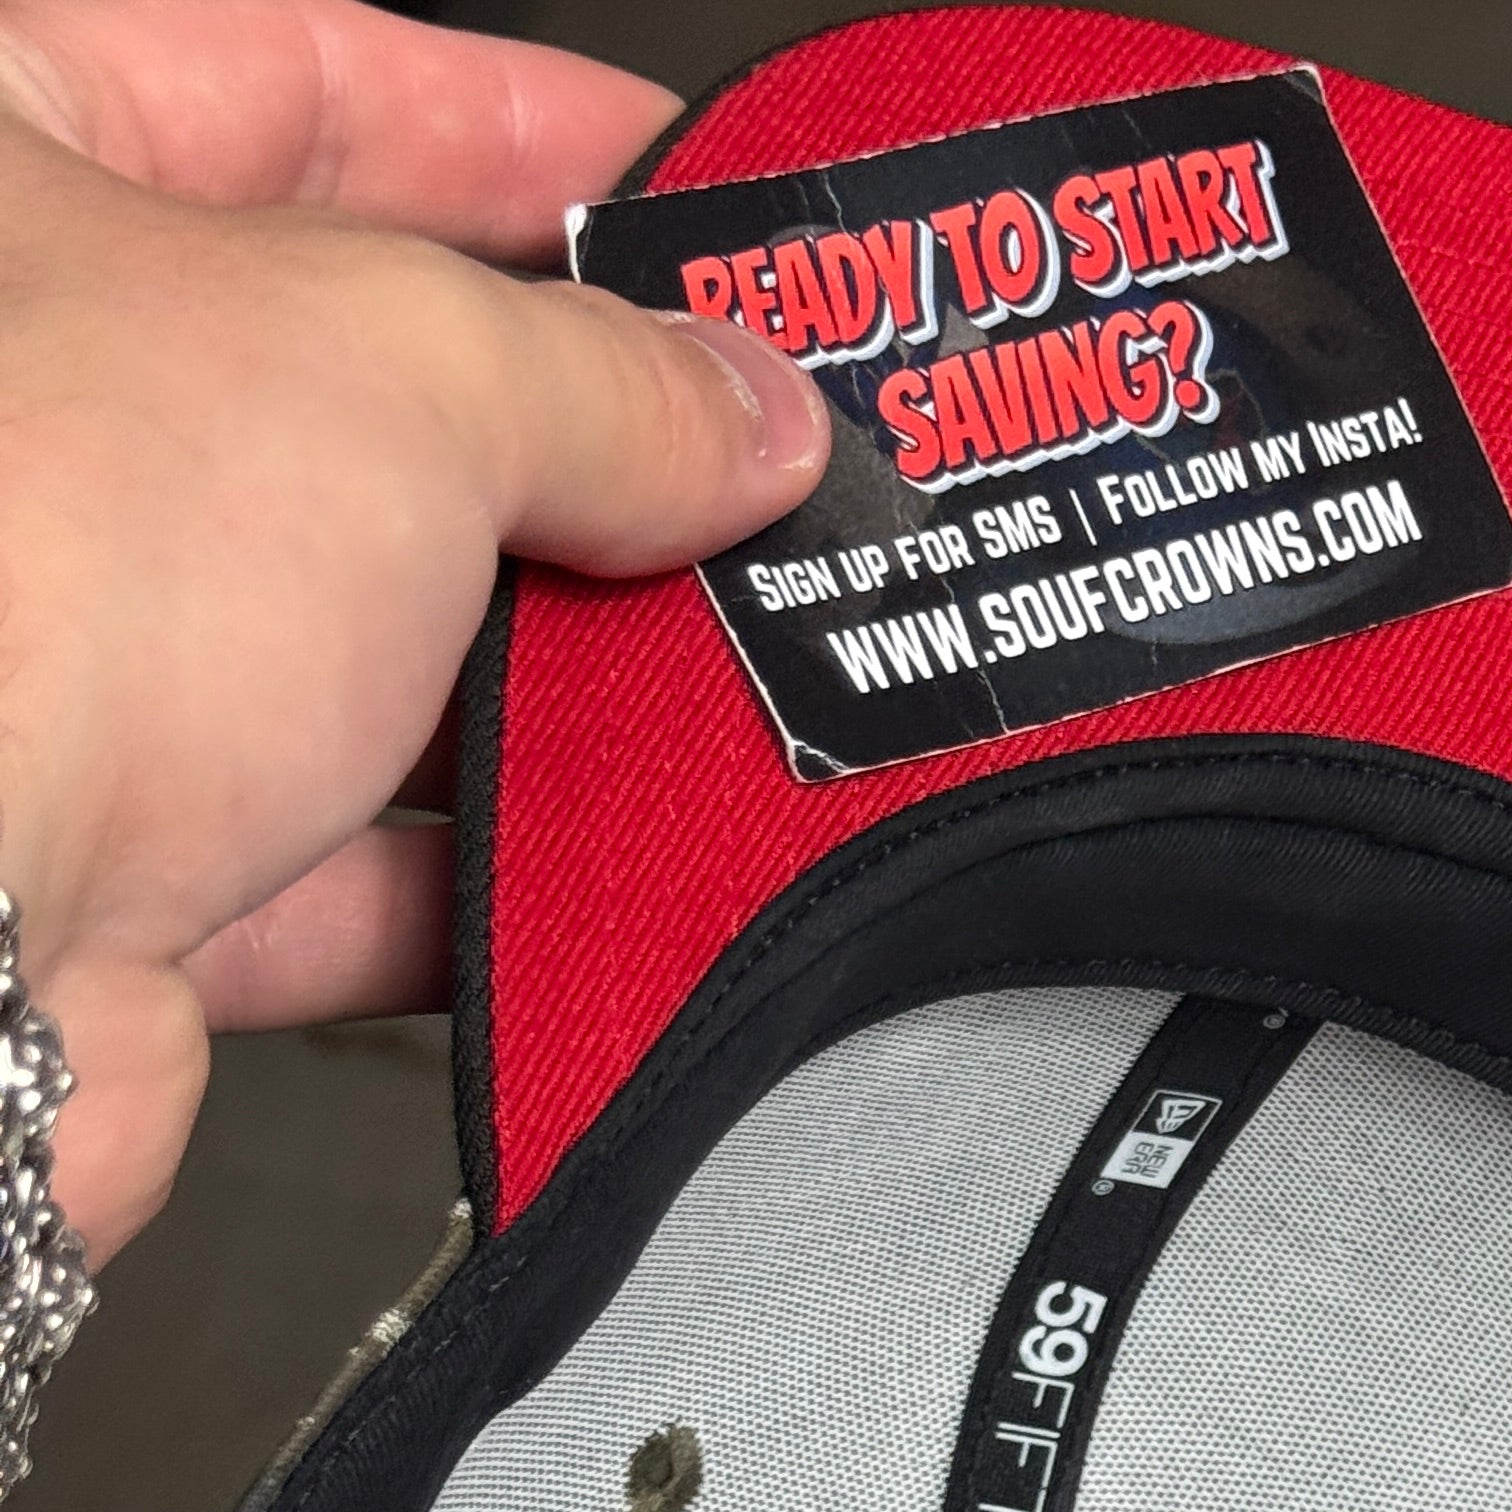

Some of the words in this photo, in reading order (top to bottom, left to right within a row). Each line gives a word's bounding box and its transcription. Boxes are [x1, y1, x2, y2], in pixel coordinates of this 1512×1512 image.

[681, 219, 939, 368] READY
[930, 187, 1061, 330] TO
[1052, 138, 1290, 299] START
[876, 299, 1221, 494] SAVING?
[747, 556, 842, 612] SIGN
[838, 544, 890, 593] UP
[894, 524, 976, 581] FOR
[972, 495, 1062, 560] SMS
[1095, 446, 1250, 526] FOLLOW
[1249, 430, 1307, 484] MY
[825, 478, 1424, 695] WWW.SOUFCROWNS.COM
[1120, 1141, 1155, 1175] ERA
[1140, 1144, 1174, 1179] NEW
